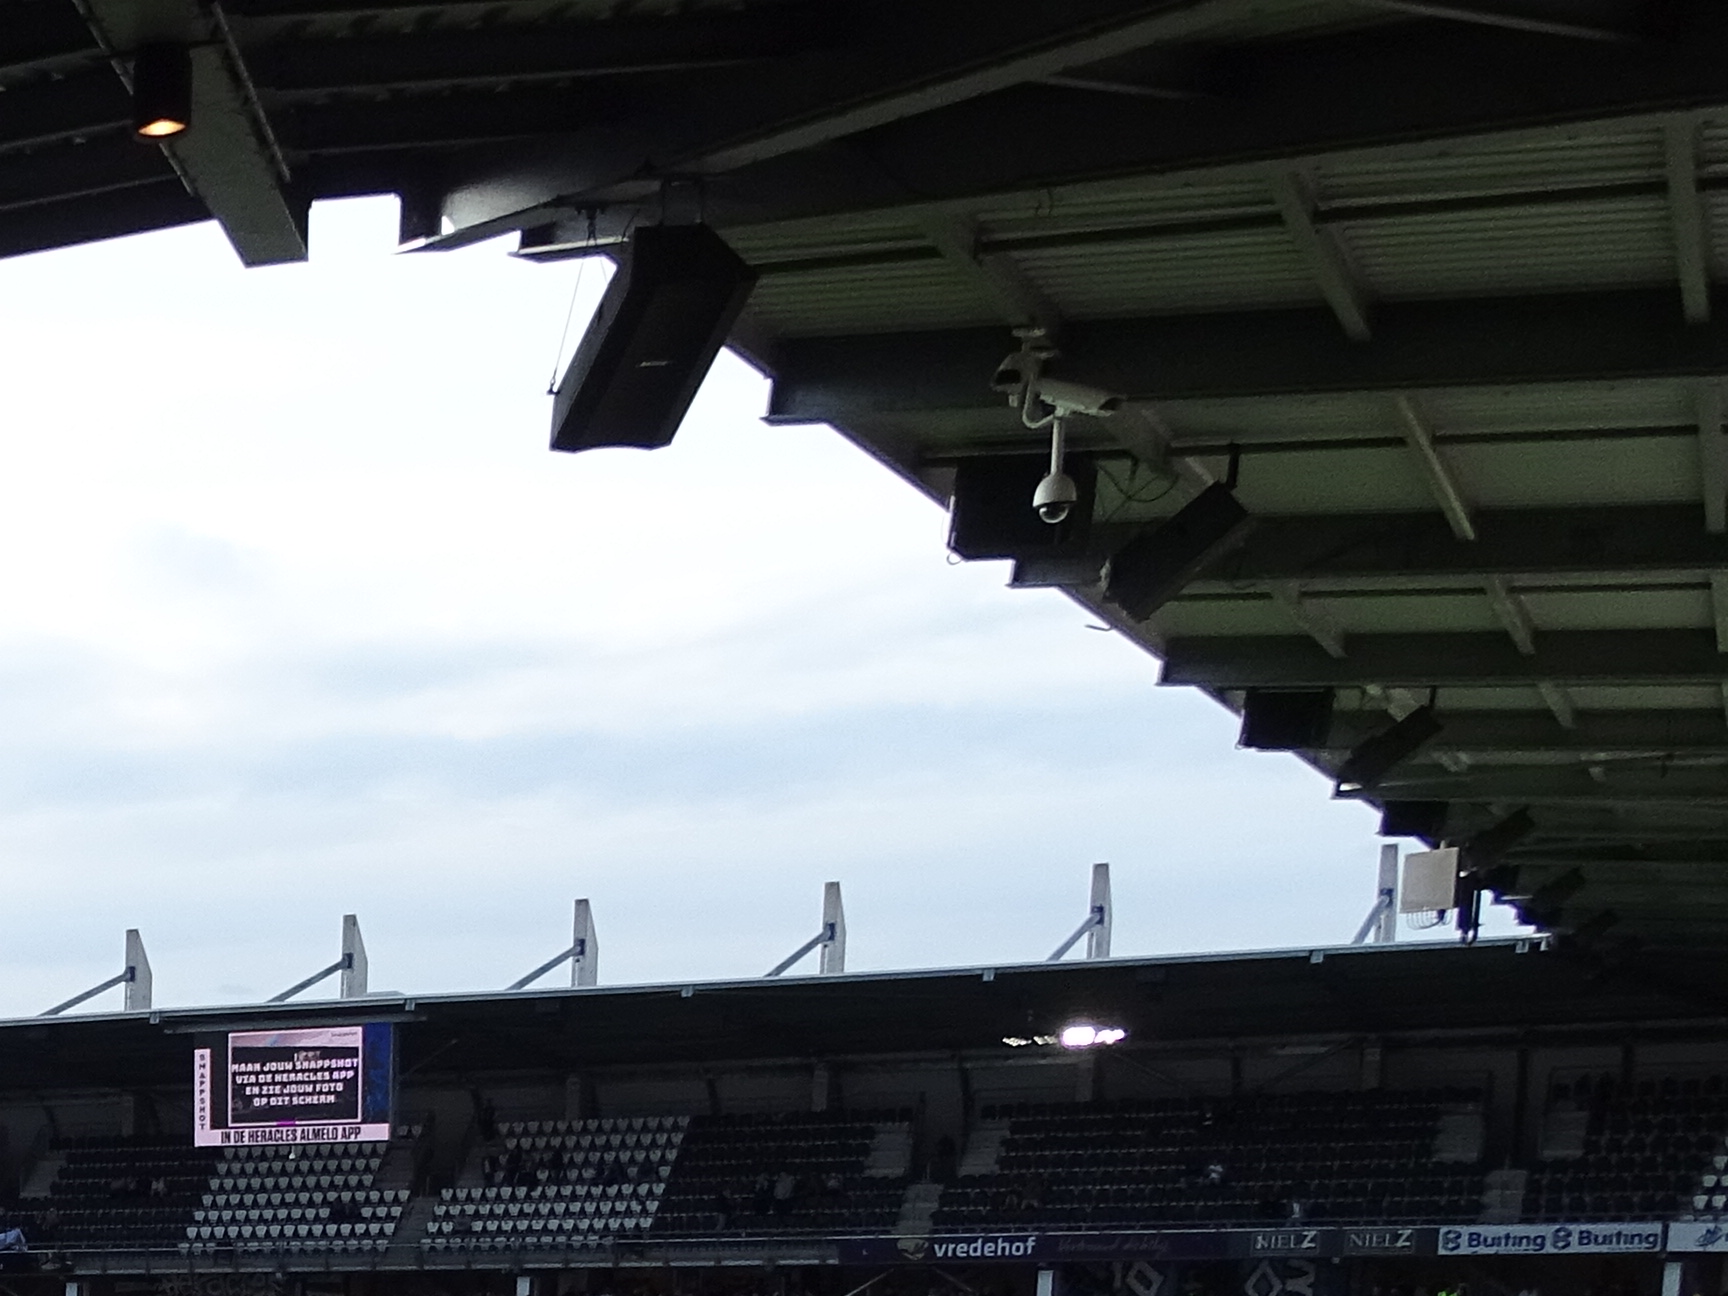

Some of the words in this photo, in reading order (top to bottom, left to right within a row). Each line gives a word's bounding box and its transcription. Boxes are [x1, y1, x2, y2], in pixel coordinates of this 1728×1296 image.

[263, 1061, 293, 1072] JOUW
[235, 1074, 257, 1084] VIA
[258, 1073, 273, 1083] DE
[275, 1072, 330, 1082] HERACLES
[332, 1070, 355, 1080] APP
[261, 1085, 281, 1094] ZIE
[283, 1083, 314, 1093] JOUW
[315, 1082, 344, 1092] FOTO
[253, 1097, 269, 1106] OP
[270, 1096, 290, 1105] DIT
[292, 1094, 335, 1105] SCHERM
[221, 1131, 233, 1143] IN
[234, 1130, 247, 1143] DE
[248, 1129, 298, 1142] HERACLES
[299, 1128, 339, 1141] ALMELO
[340, 1127, 361, 1140] APP
[1349, 1229, 1412, 1247] NIELZ
[933, 1237, 1037, 1258] vredehof
